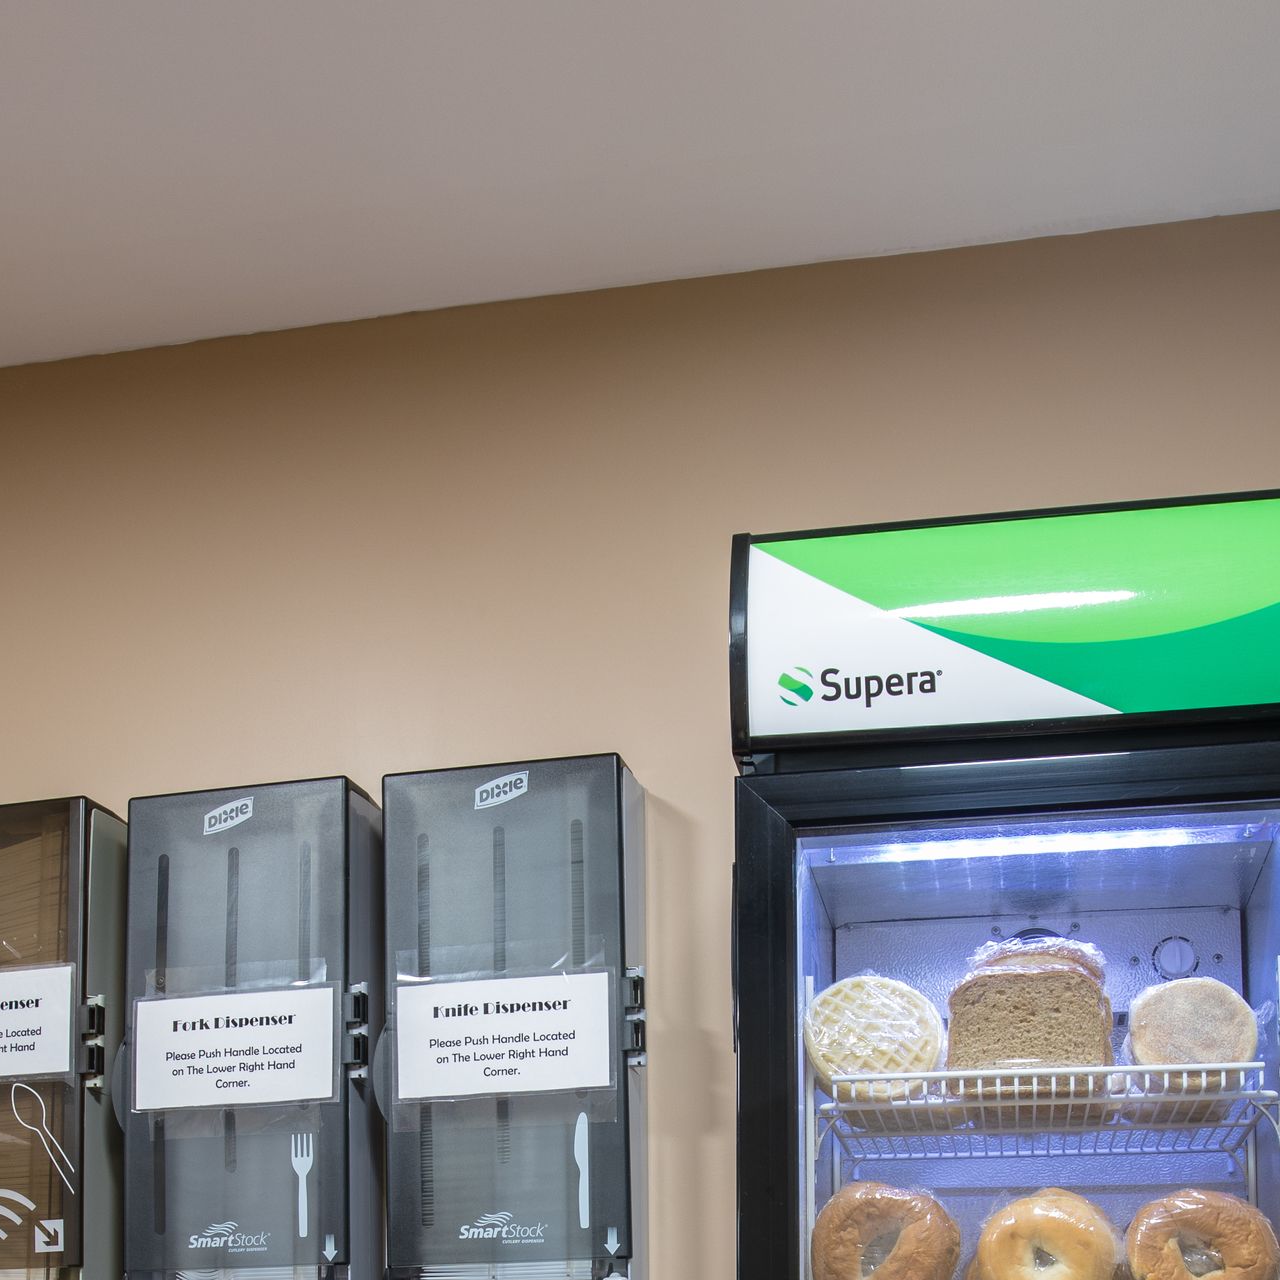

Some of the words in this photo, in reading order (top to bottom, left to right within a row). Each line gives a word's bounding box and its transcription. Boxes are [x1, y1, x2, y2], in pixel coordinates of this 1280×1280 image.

[820, 667, 936, 708] Supera
[433, 1003, 479, 1019] Knife
[483, 999, 571, 1015] Dispenser
[5, 1026, 42, 1038] Located
[172, 1018, 210, 1033] Fork
[214, 1013, 296, 1030] Dispenser
[10, 1042, 36, 1052] Hand
[429, 1038, 462, 1049] Please
[464, 1035, 489, 1046] Push
[492, 1033, 530, 1044] Handle
[533, 1030, 576, 1042] Located
[165, 1051, 196, 1061] Please
[198, 1048, 221, 1059] Push
[224, 1046, 260, 1057] Handle
[262, 1043, 302, 1055] Located
[436, 1055, 449, 1064] on
[451, 1052, 471, 1063] The
[473, 1050, 505, 1061] Lower
[508, 1048, 536, 1061] Right
[538, 1046, 569, 1057] Hand
[172, 1068, 184, 1077] on
[186, 1065, 204, 1075] The
[206, 1063, 236, 1074] Lower
[239, 1061, 265, 1073] Right
[267, 1059, 296, 1070] Hand
[483, 1066, 521, 1077] Corner.
[215, 1079, 251, 1089] Corner.
[188, 1231, 268, 1248] SmartStock
[459, 1222, 544, 1239] SmartStock
